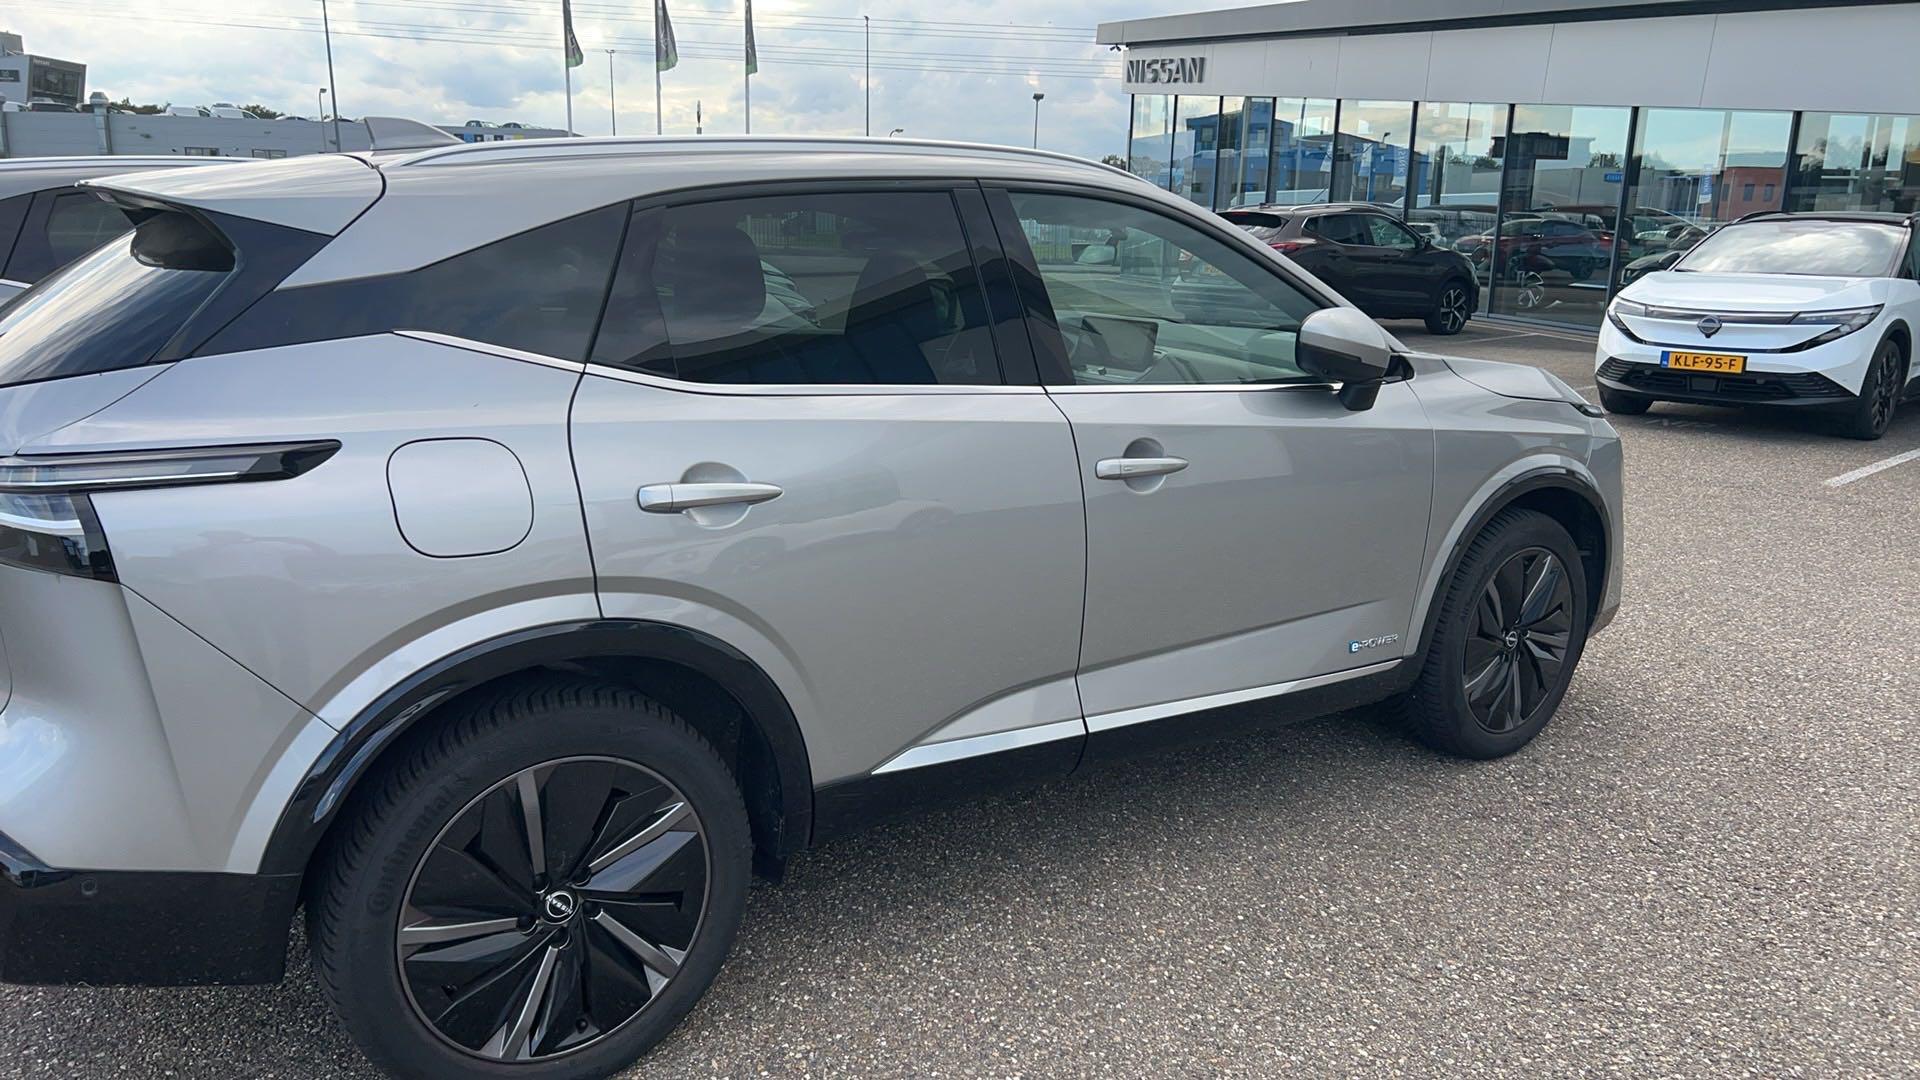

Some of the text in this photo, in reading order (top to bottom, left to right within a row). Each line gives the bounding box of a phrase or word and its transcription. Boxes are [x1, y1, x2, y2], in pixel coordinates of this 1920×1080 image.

[1126, 57, 1206, 83] NISSAN
[1674, 354, 1737, 370] KLF-95-F
[1350, 633, 1399, 652] e-POWER
